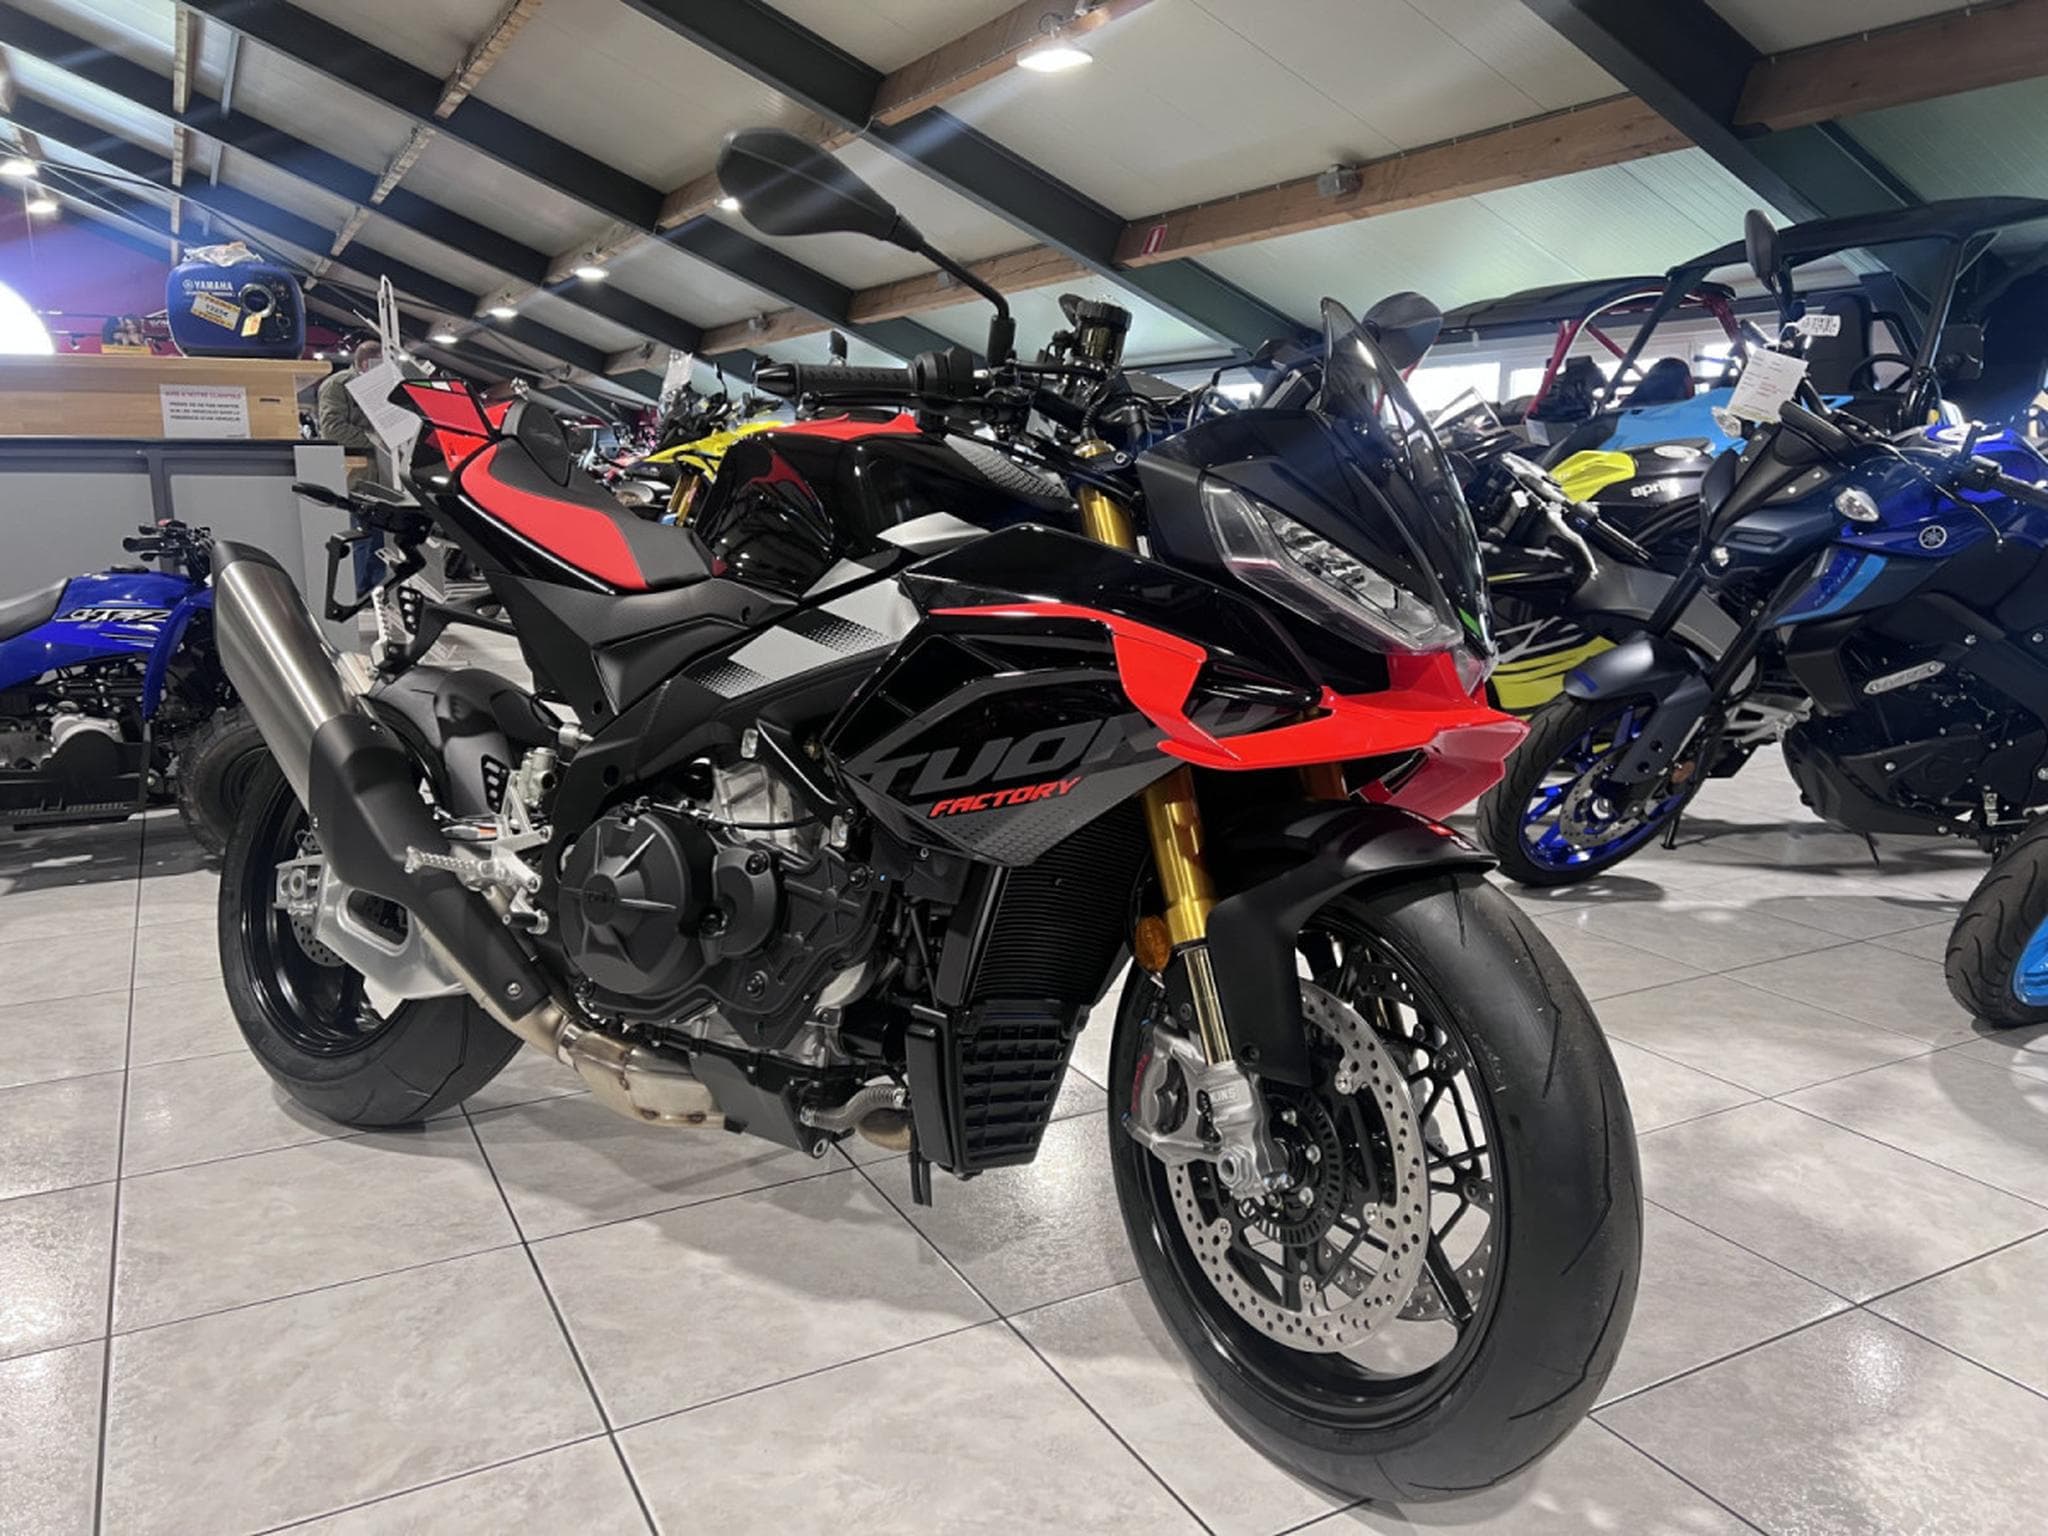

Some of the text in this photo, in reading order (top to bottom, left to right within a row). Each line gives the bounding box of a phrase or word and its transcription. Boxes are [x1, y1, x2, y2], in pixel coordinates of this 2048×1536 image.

[194, 281, 233, 291] YAMAHA
[1630, 478, 1681, 498] apri
[929, 776, 1083, 818] FACTORY
